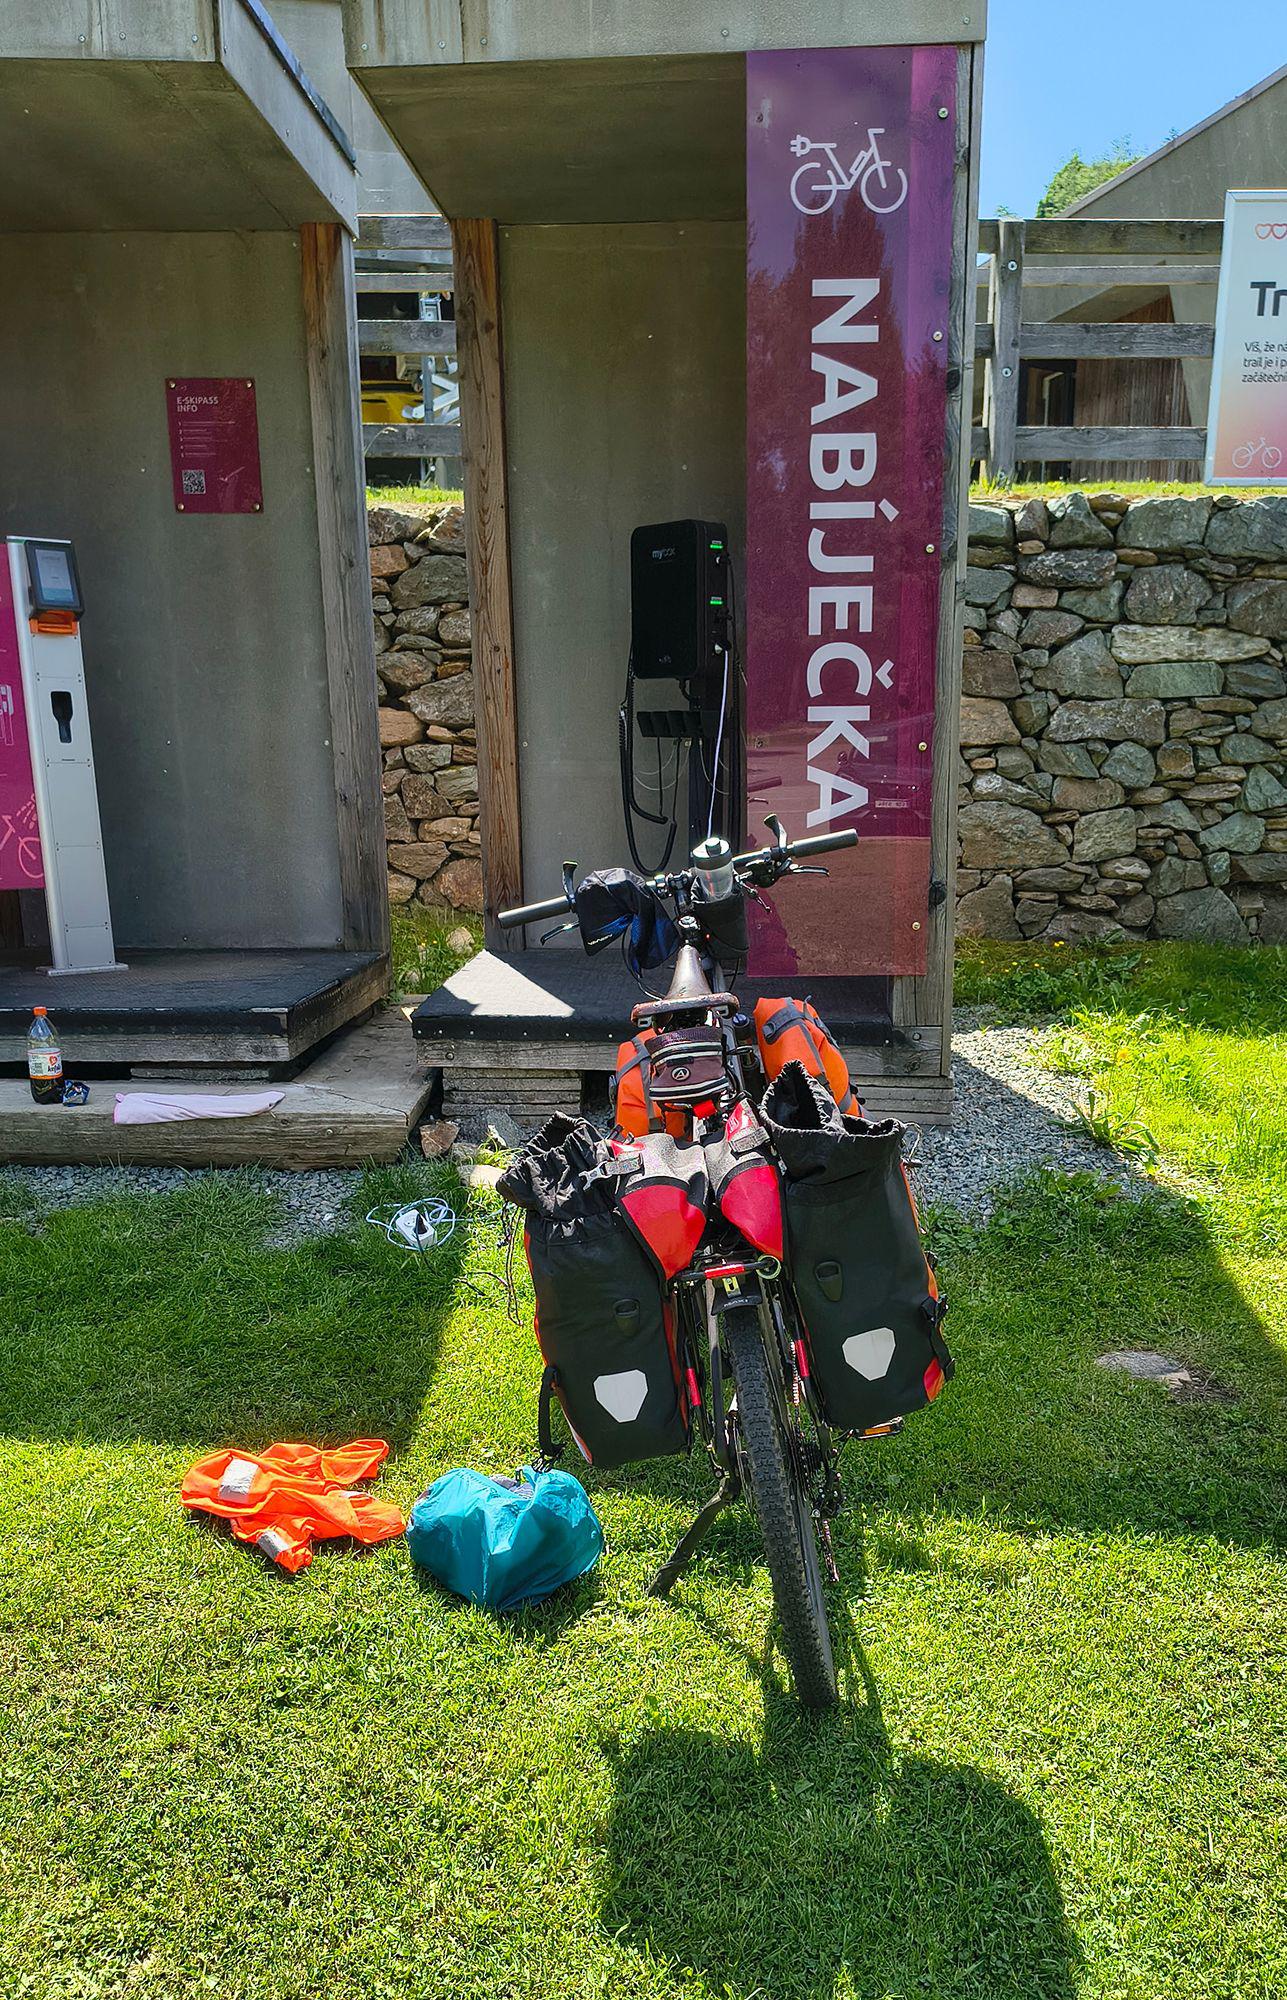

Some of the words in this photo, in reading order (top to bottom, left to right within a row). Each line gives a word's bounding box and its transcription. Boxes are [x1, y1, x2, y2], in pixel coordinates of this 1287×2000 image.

[1264, 341, 1275, 352] že
[1243, 357, 1262, 367] trail
[1263, 356, 1273, 369] je
[176, 396, 219, 405] E-SKIPASS
[177, 404, 198, 413] INFO
[807, 278, 899, 828] NABÍJEČKA
